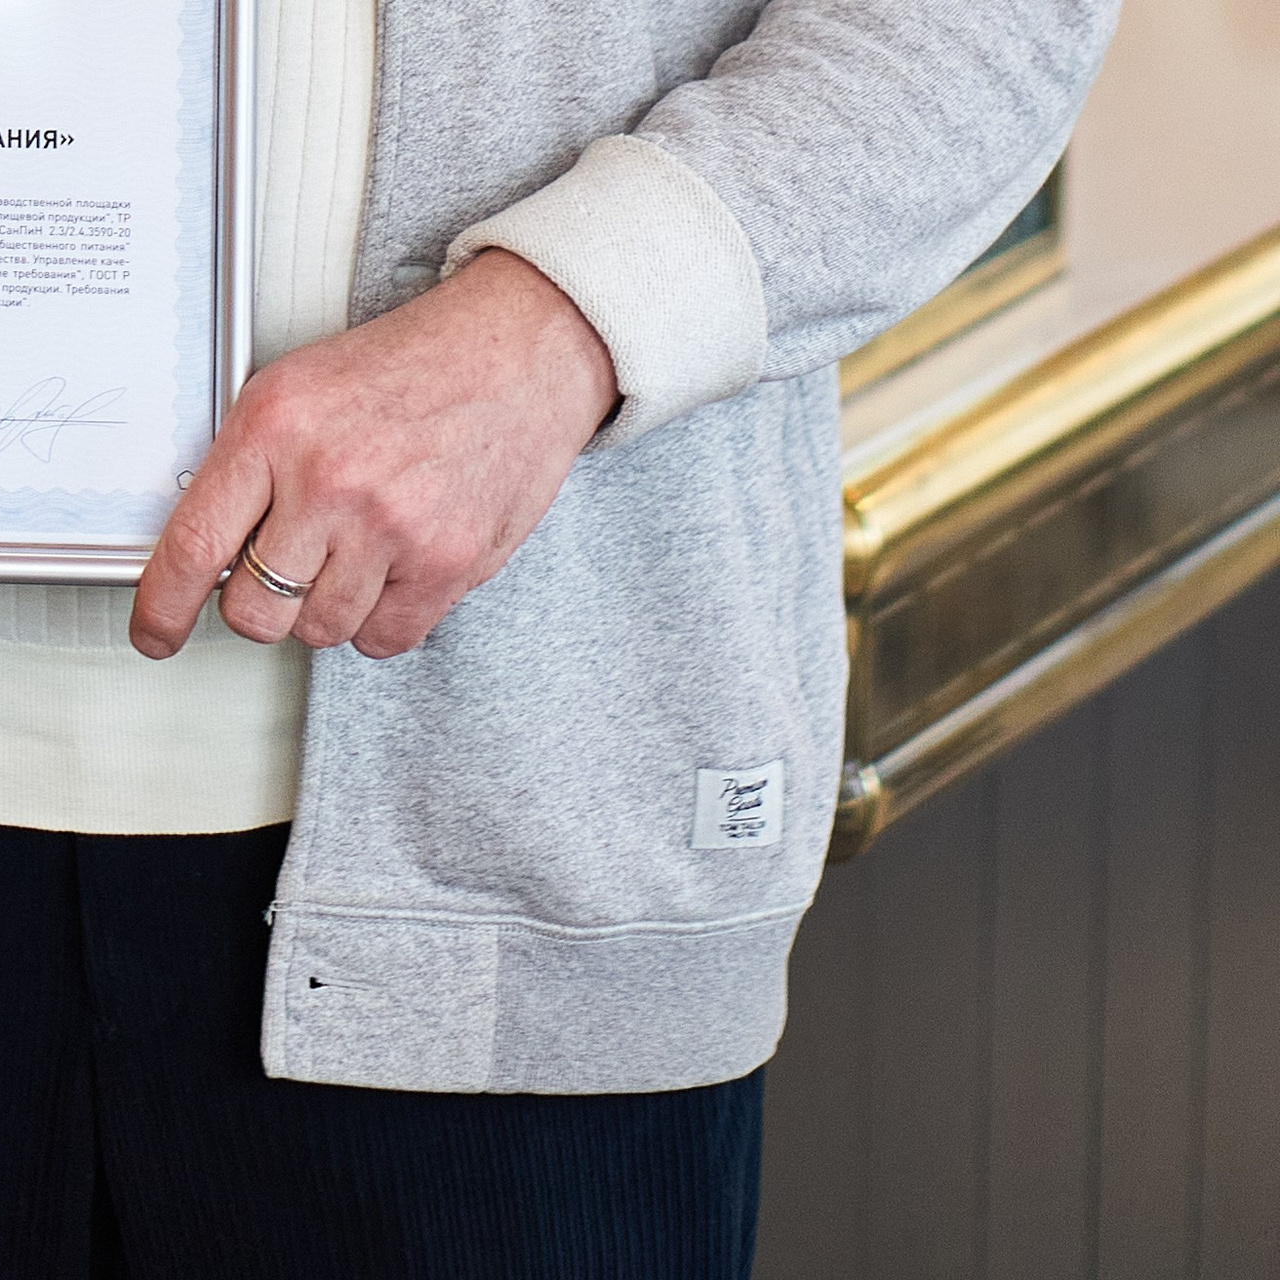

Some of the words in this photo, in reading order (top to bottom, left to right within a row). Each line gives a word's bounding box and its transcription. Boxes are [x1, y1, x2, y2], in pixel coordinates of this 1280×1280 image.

[75, 200, 131, 209] площадки
[32, 255, 98, 266] Управление
[100, 258, 130, 266] каче-
[88, 269, 118, 280] ГОСТ
[2, 284, 62, 295] продукции.
[66, 283, 130, 295] Требования
